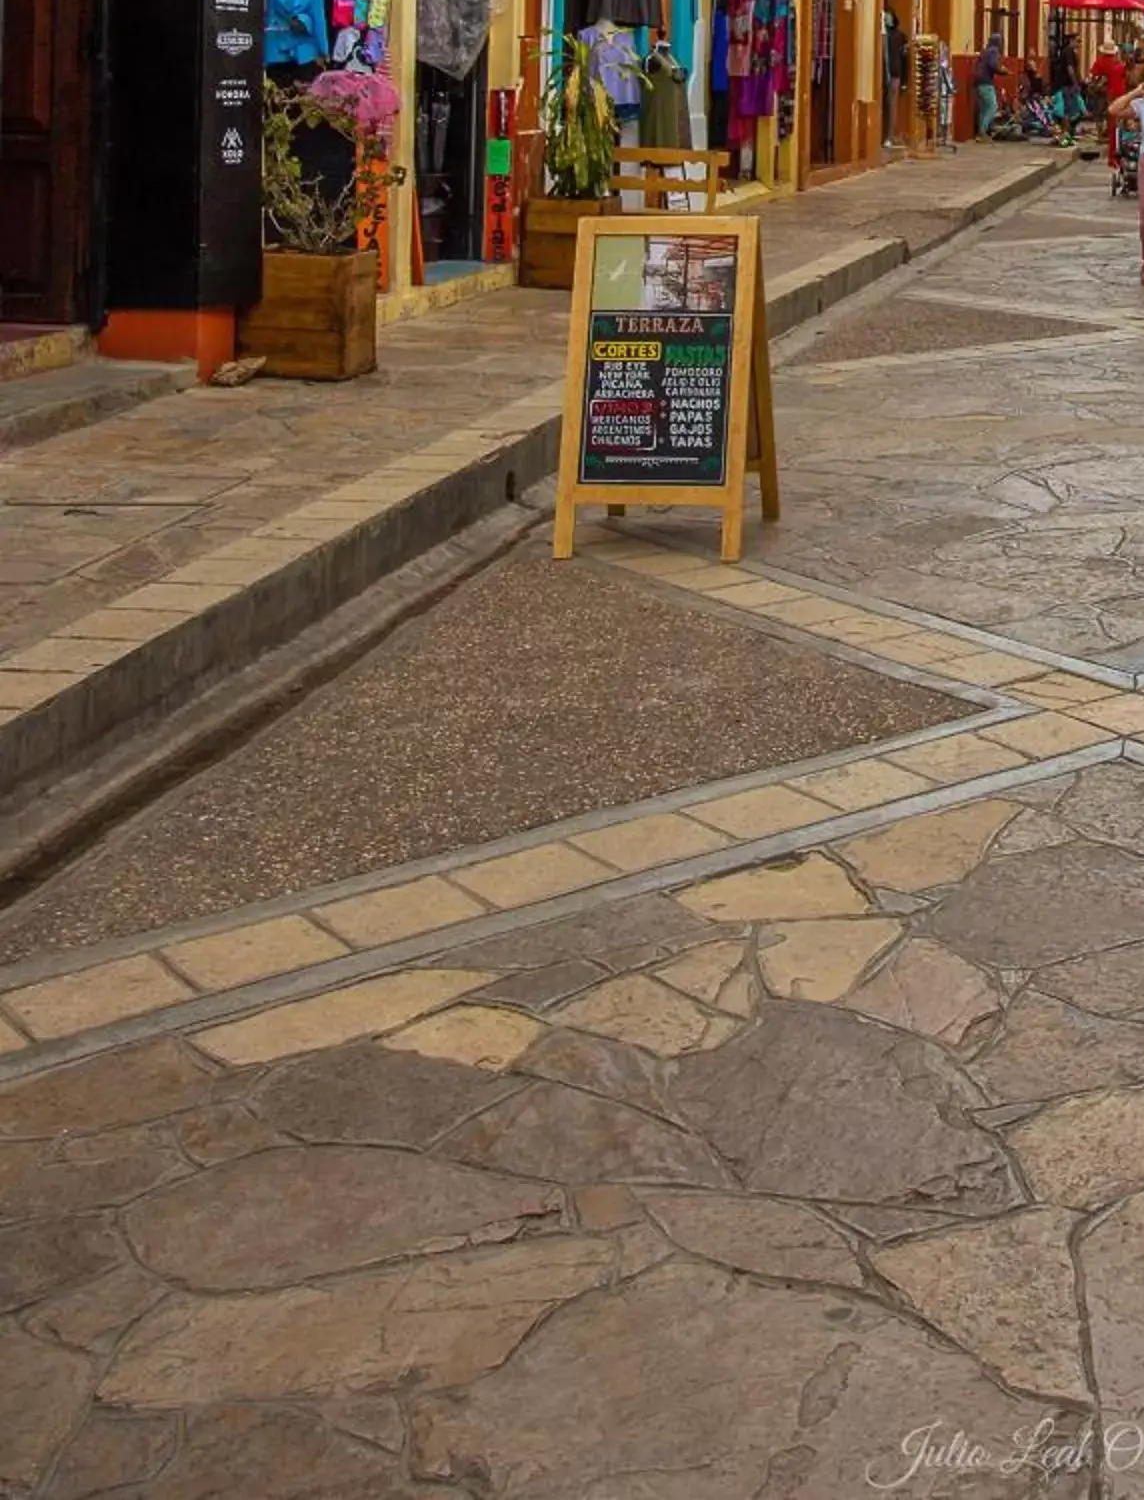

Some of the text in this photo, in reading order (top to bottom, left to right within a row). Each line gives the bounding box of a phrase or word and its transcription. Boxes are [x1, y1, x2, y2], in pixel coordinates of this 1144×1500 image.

[615, 317, 705, 333] TERRAZA
[594, 344, 657, 357] CORTES
[626, 361, 648, 371] EYE
[599, 371, 623, 381] NEW
[671, 398, 721, 411] NACHOS
[669, 411, 713, 423] PAPAS
[669, 423, 713, 435] GAJOS
[670, 435, 713, 449] TAPAS
